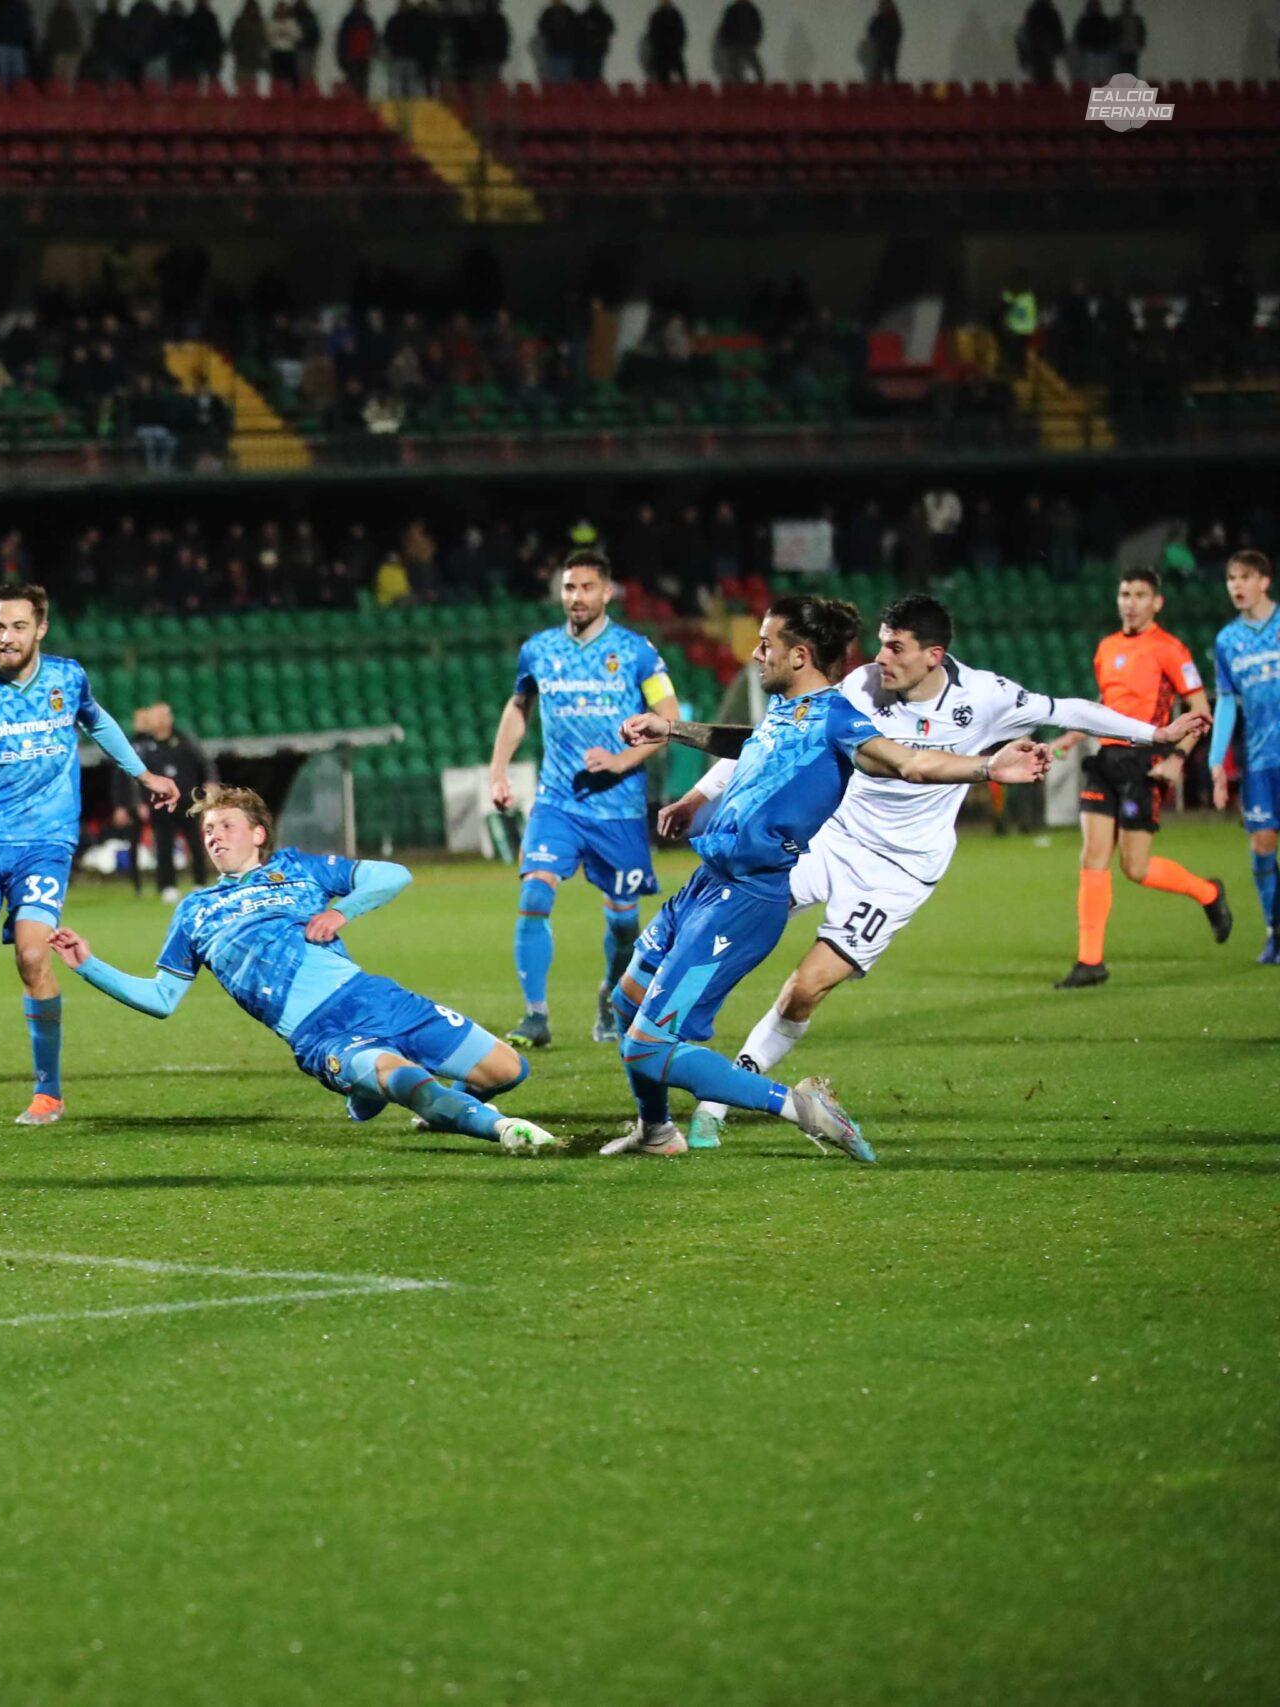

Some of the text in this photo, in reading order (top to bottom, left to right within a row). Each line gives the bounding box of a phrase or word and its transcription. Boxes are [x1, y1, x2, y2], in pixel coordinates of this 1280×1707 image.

[22, 875, 60, 908] 32
[614, 868, 645, 895] 19
[843, 901, 888, 943] 20
